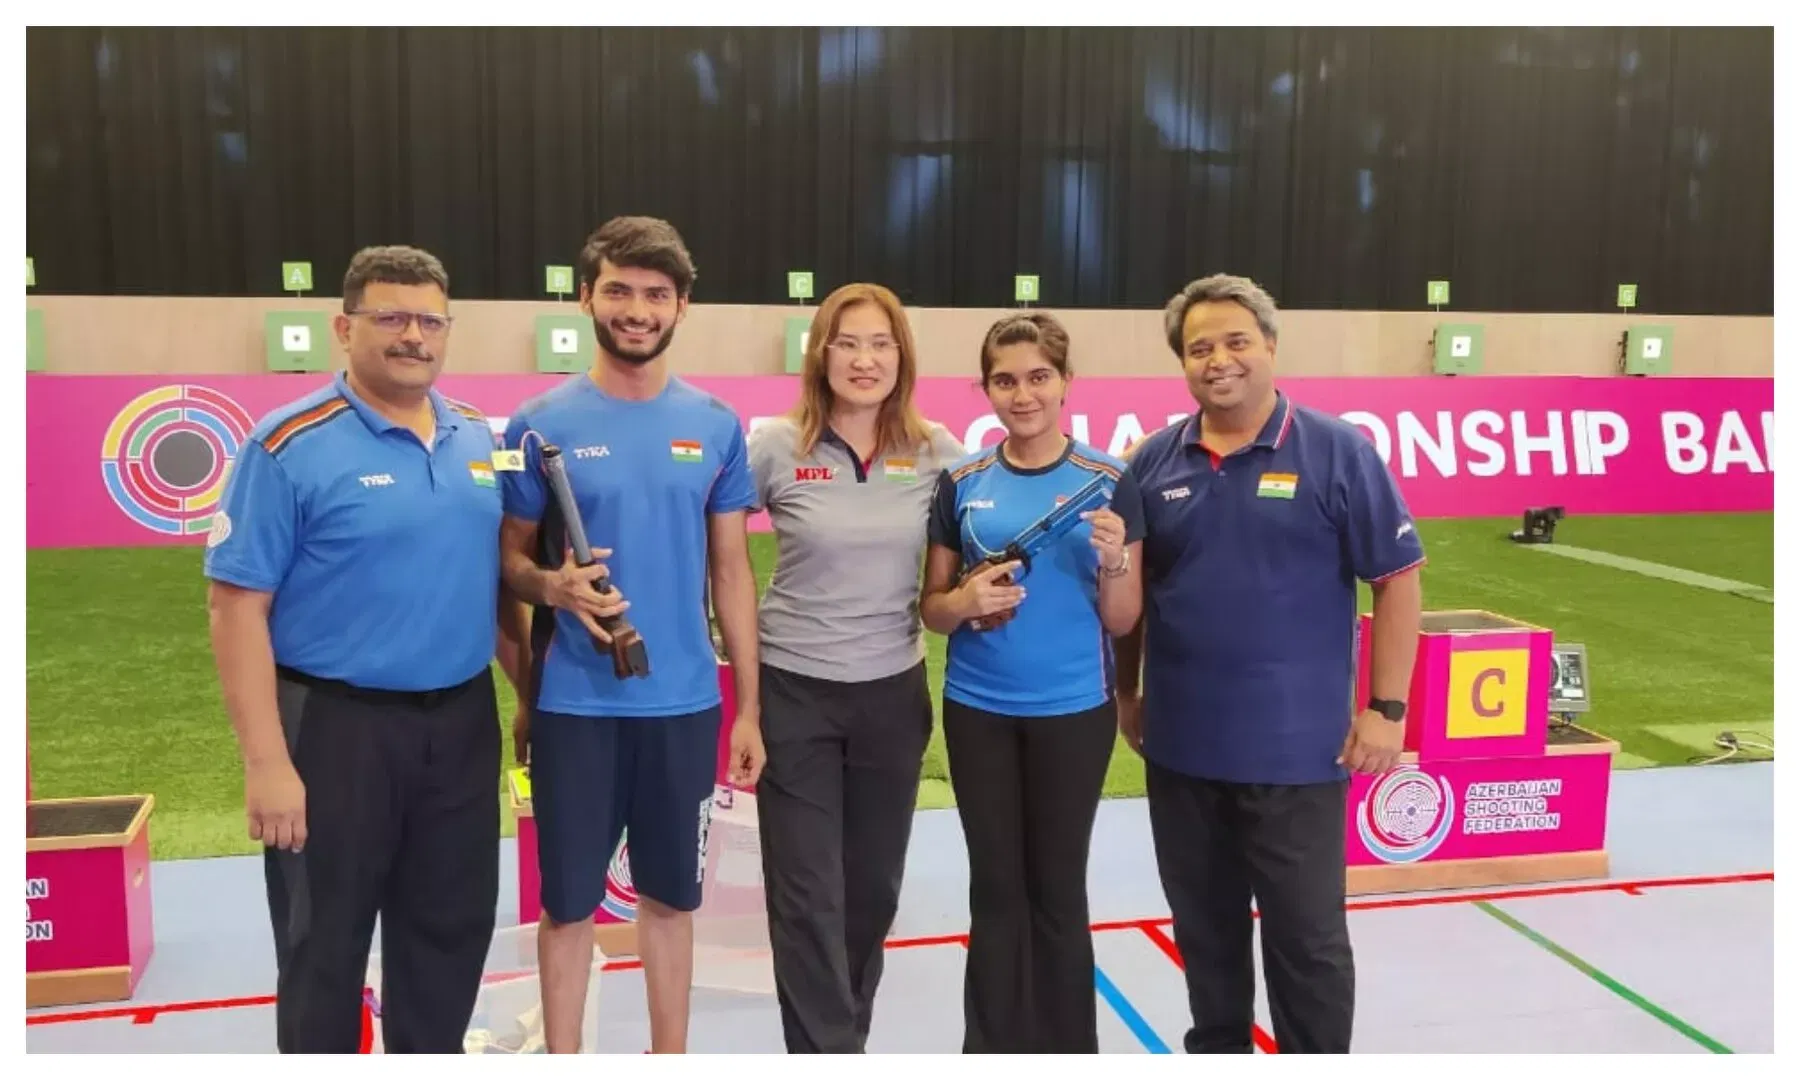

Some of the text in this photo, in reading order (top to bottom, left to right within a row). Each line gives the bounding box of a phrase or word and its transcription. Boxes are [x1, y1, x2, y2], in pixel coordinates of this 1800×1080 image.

[290, 267, 305, 284] A
[795, 276, 808, 294] C
[963, 410, 1775, 478] CAONSHIP BA
[795, 467, 833, 481] MPL
[1471, 667, 1506, 718] C
[1467, 781, 1560, 798] AZERBAIJAN
[1466, 800, 1546, 816] SHOOTING
[1465, 816, 1558, 831] FEDERATION
